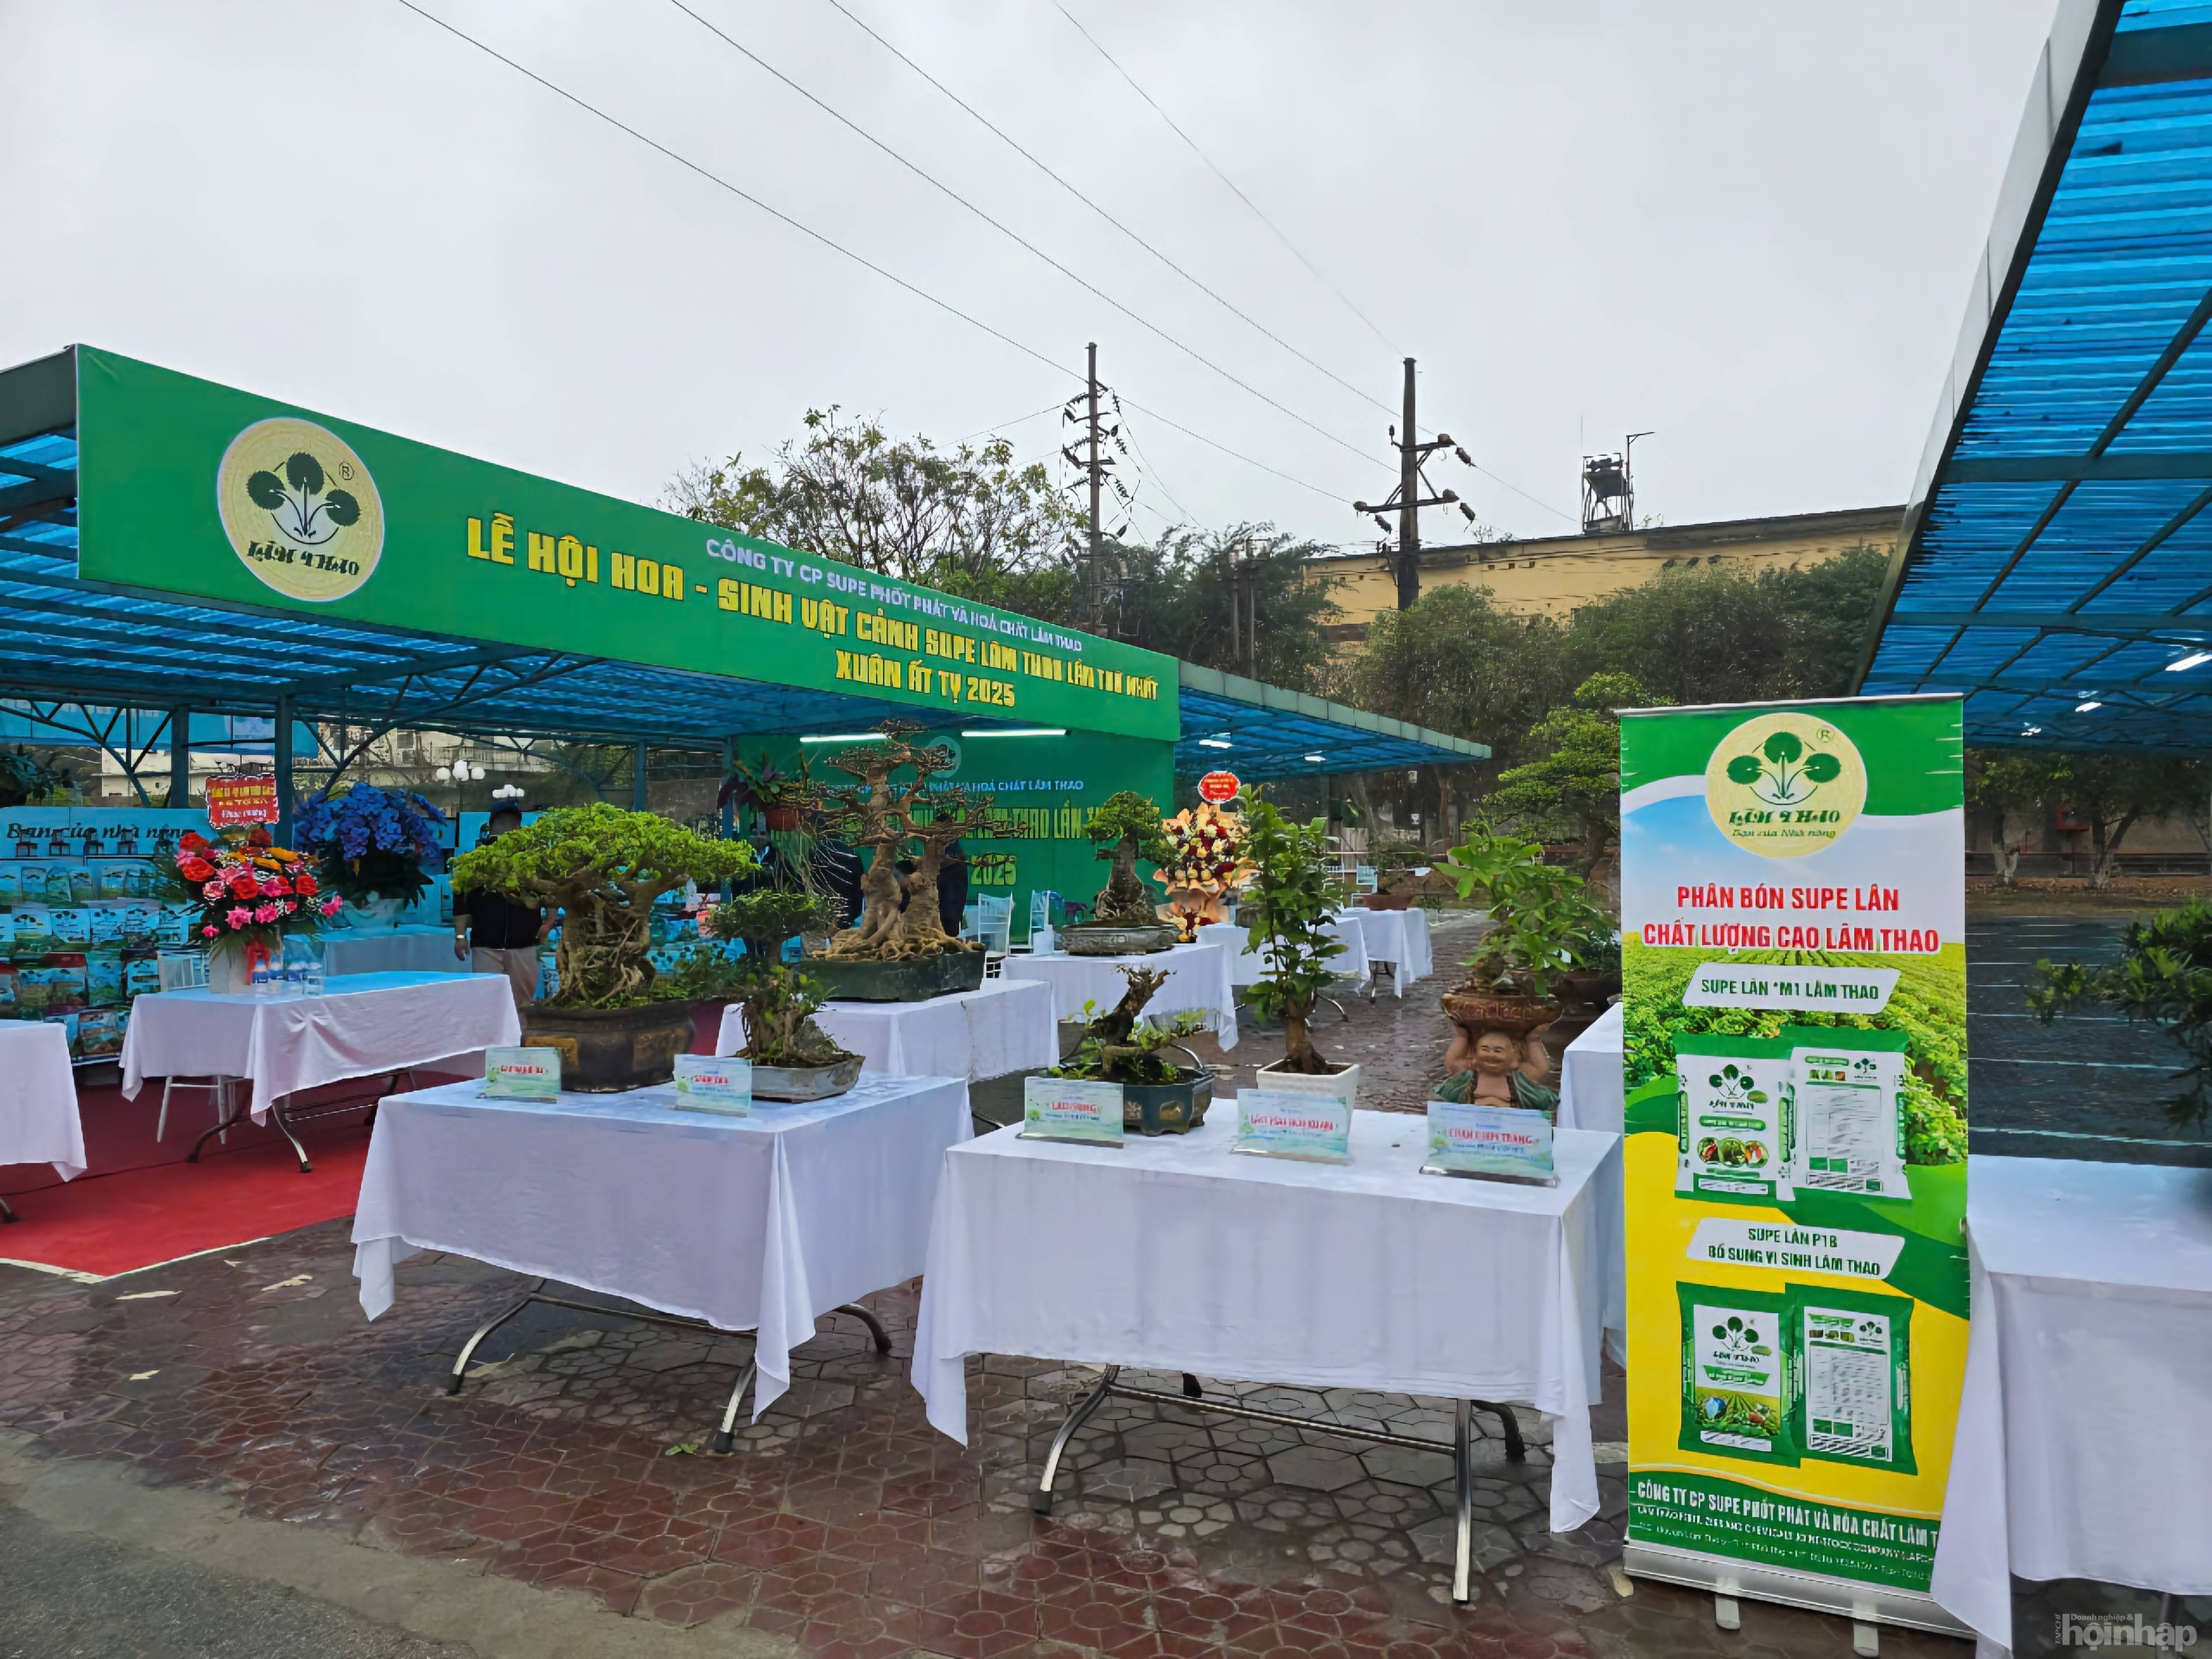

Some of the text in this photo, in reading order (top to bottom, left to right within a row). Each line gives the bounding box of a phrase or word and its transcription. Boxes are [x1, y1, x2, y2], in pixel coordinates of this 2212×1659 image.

[706, 539, 766, 570] CÔNG
[770, 556, 795, 577] TY
[800, 564, 823, 585] CP
[827, 572, 866, 597] SUPE
[467, 512, 514, 565] LỄ
[528, 532, 599, 588] HỘI
[611, 552, 684, 600] HOA
[718, 578, 793, 624] SINH
[857, 608, 918, 651] CẢNH
[925, 628, 975, 663] SUPE
[981, 641, 1017, 672] LÂM
[836, 650, 901, 688] XUÂN
[908, 659, 932, 694] ẤT
[967, 677, 1016, 707] 2025
[1055, 780, 1084, 790] THAO
[970, 851, 1017, 885] 2025
[1677, 882, 1899, 911] PHÂN BÓN SUPE LÂN
[1644, 918, 1940, 953] CHẤT LƯỢNG CAO LÂM THAO
[1702, 979, 1737, 995] SUPE
[1741, 978, 1769, 996] LÂN
[1805, 980, 1838, 999] LÂM
[1840, 984, 1880, 1000] THAO
[1748, 1228, 1781, 1243] SUPE
[1785, 1228, 1809, 1246] LÂN
[1728, 1247, 1763, 1264] SUNG
[1766, 1251, 1777, 1265] VI
[1781, 1252, 1812, 1268] SINH
[1815, 1255, 1843, 1272] LÂM
[1846, 1259, 1880, 1276] THAO
[1638, 1479, 1670, 1502] CÔNG
[1672, 1487, 1687, 1506] TY
[1690, 1490, 1706, 1509] CP
[1708, 1494, 1741, 1514] SUPE
[1814, 1508, 1831, 1530] VÀ
[1863, 1517, 1897, 1541] CHẤT
[1899, 1524, 1928, 1547] LÂM
